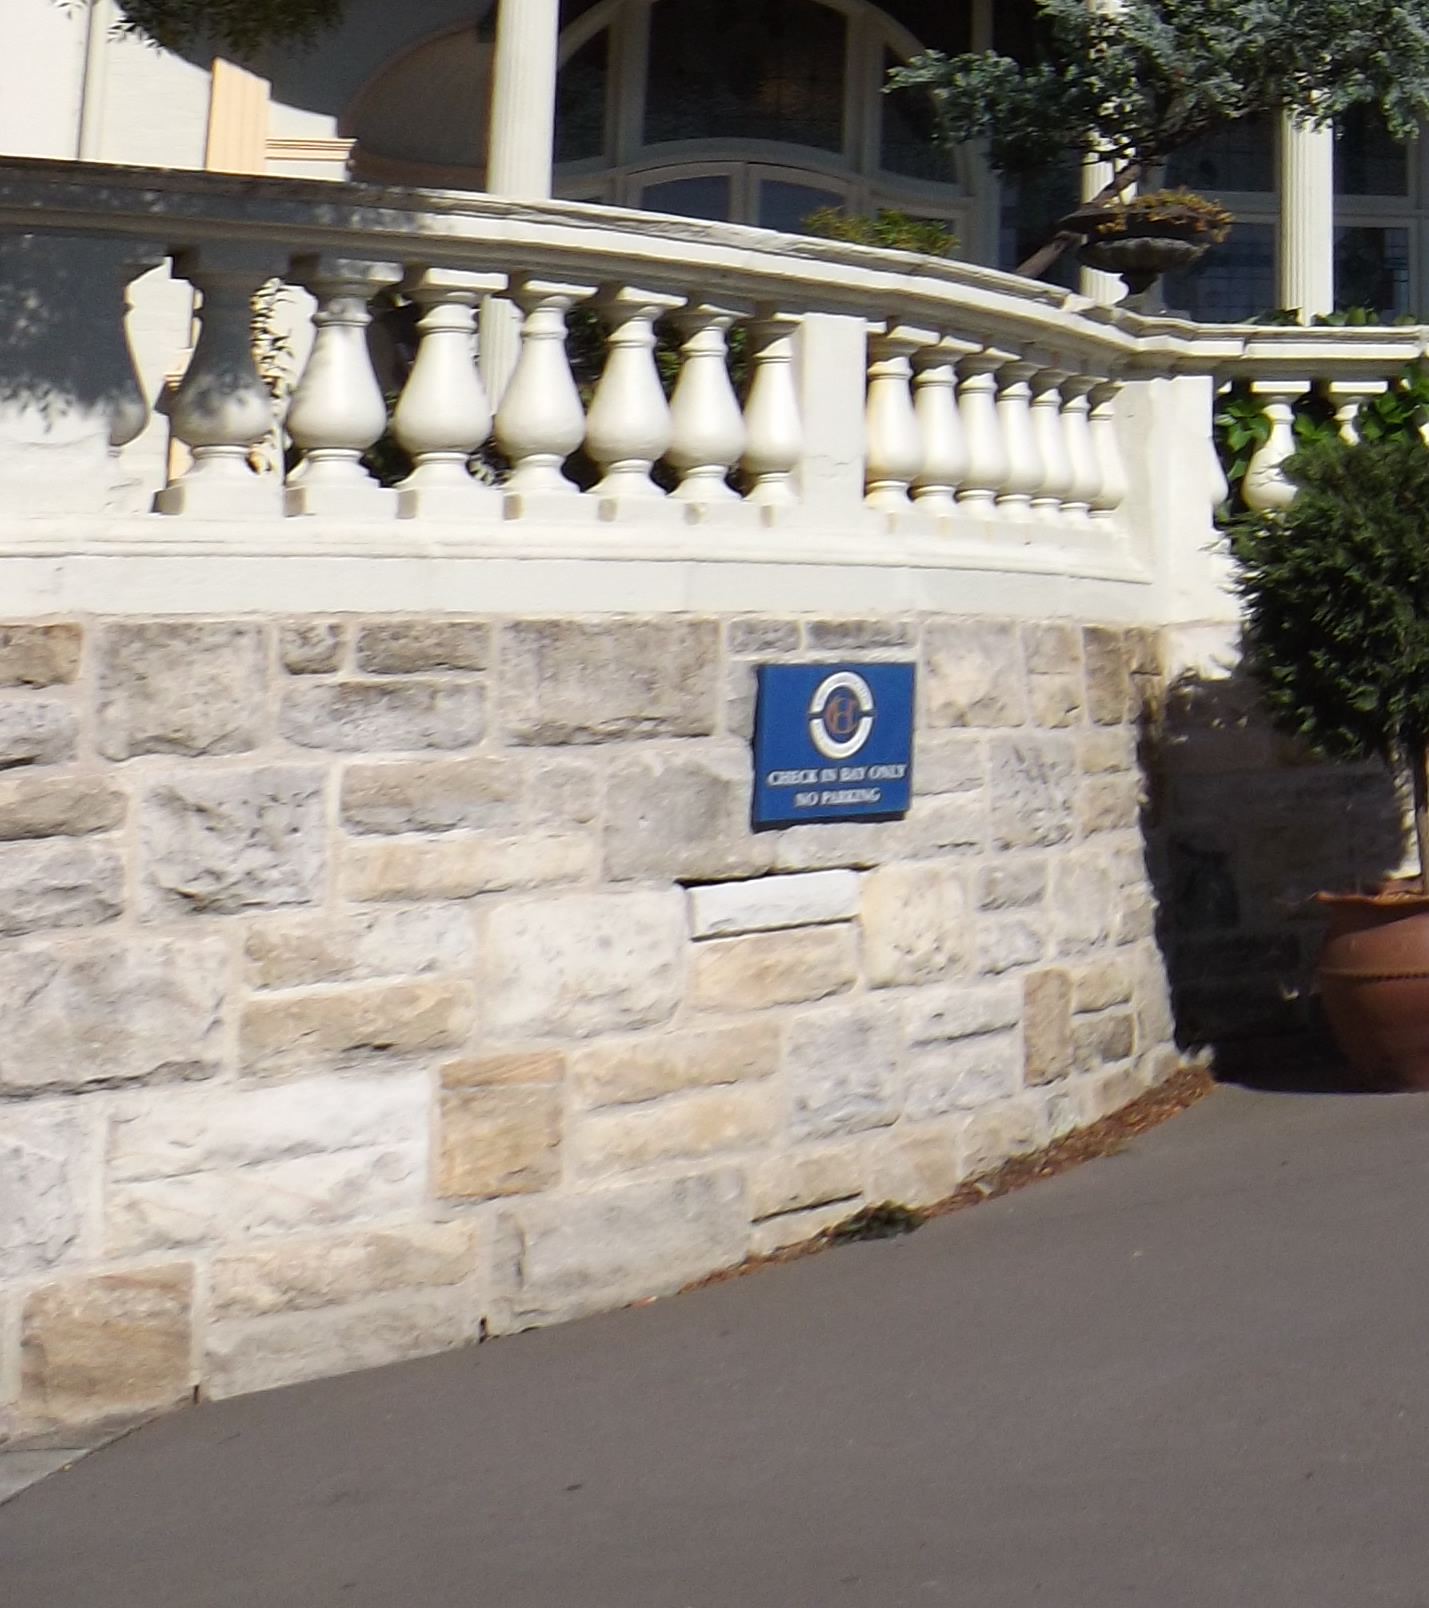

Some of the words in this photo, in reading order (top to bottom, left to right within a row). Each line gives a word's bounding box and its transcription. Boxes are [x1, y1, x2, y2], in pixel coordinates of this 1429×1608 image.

[768, 770, 819, 786] CHECK
[820, 768, 837, 782] IN
[840, 766, 867, 782] BAY
[868, 764, 906, 780] ONLY
[795, 791, 819, 807] NO
[821, 787, 881, 805] PARKING
